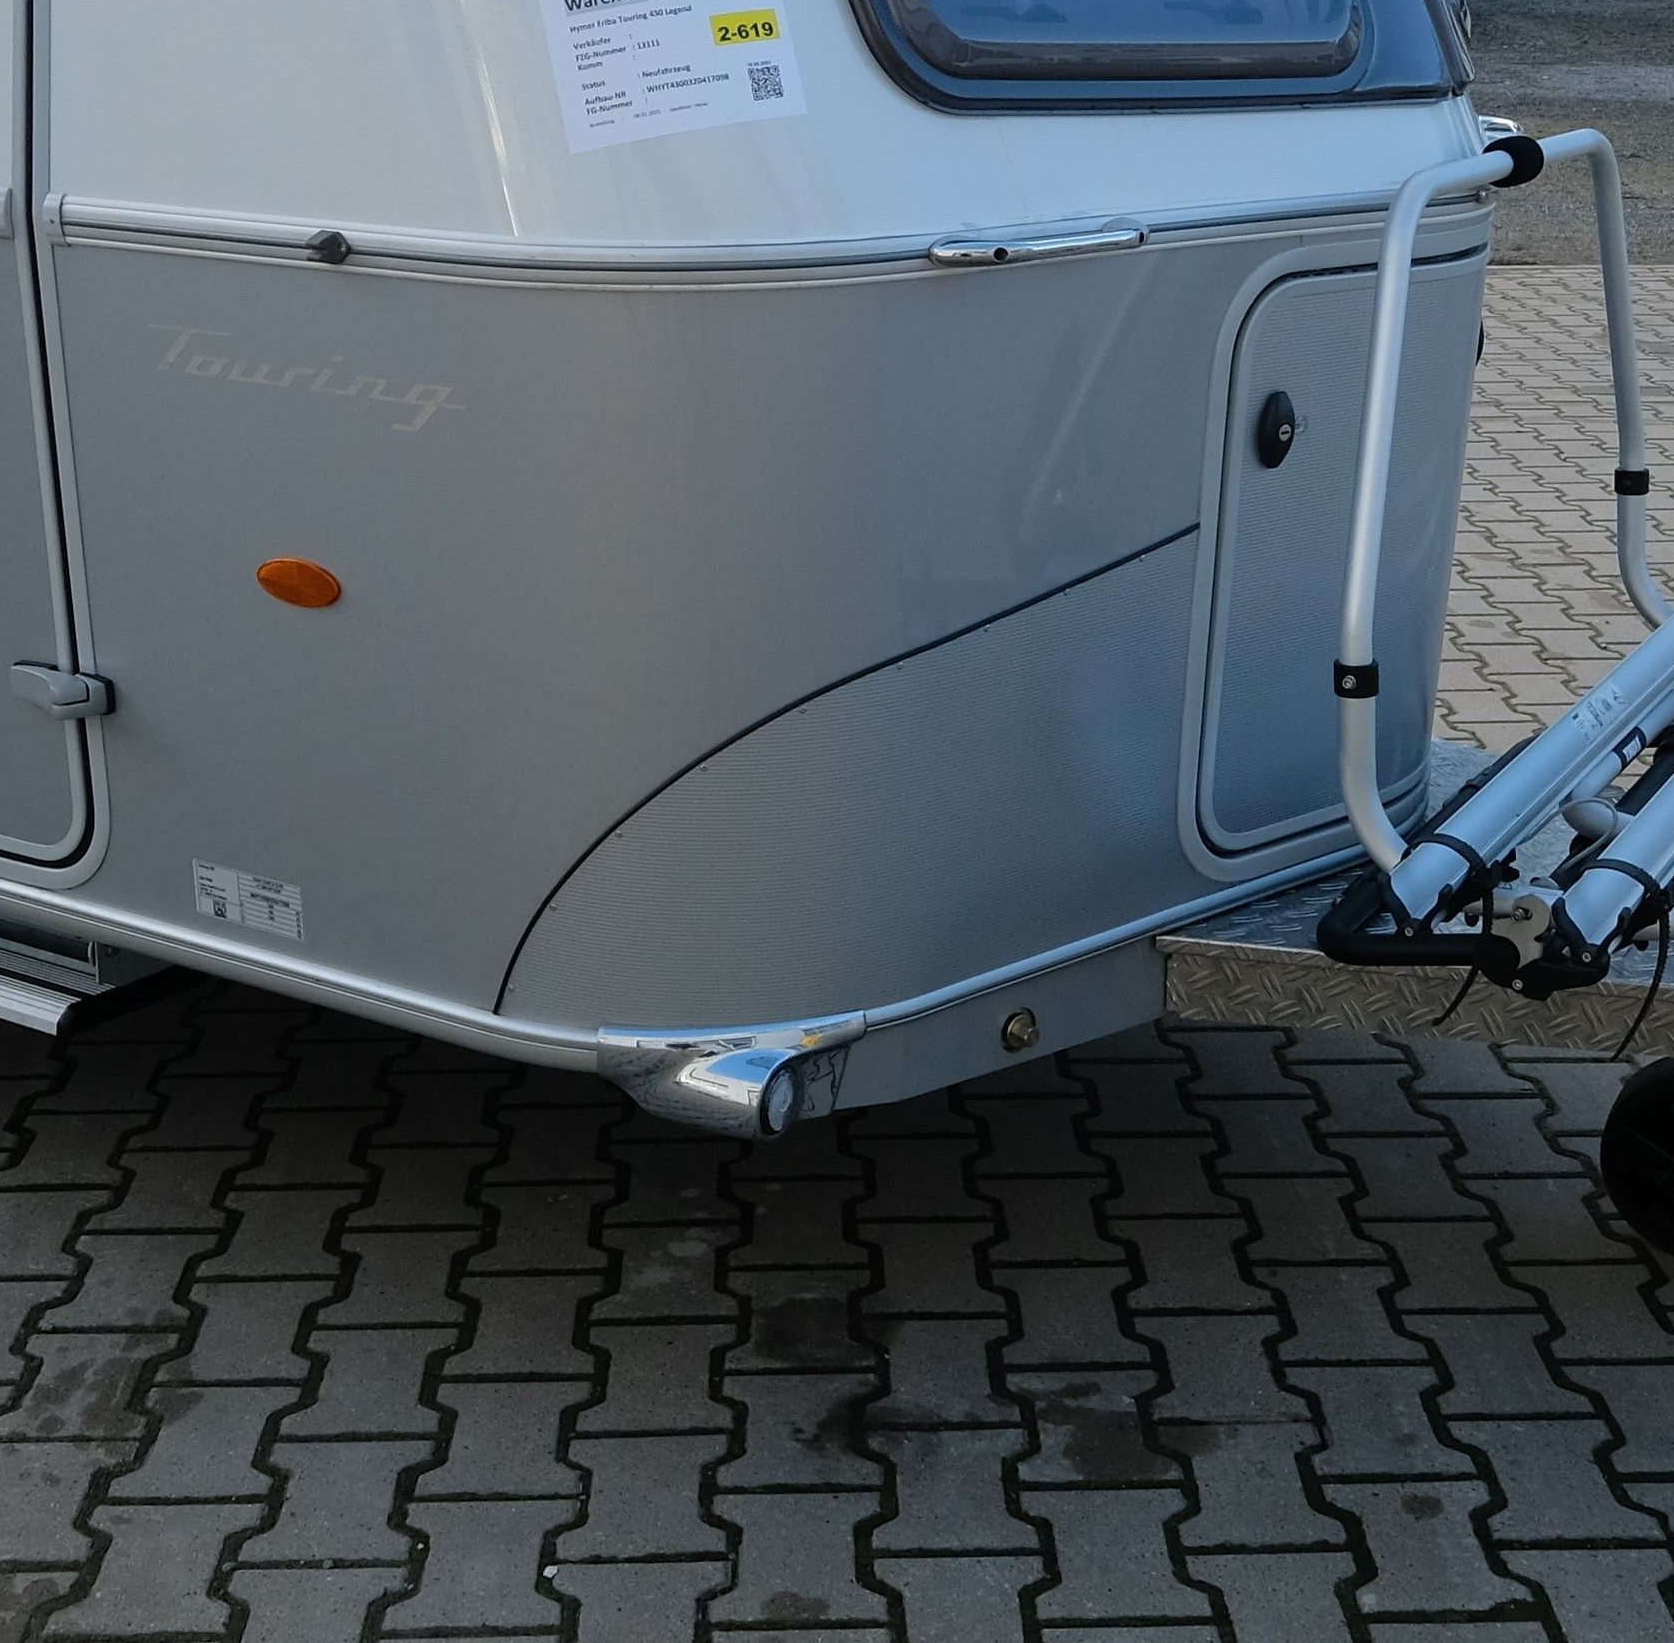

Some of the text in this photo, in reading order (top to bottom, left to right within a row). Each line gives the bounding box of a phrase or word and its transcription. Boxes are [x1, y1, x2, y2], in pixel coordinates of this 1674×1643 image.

[618, 12, 648, 24] Touring
[665, 5, 692, 16] Legend
[717, 21, 774, 42] 2-619
[573, 37, 611, 50] Verkäufer
[581, 80, 606, 91] Status
[148, 323, 471, 433] Touring
